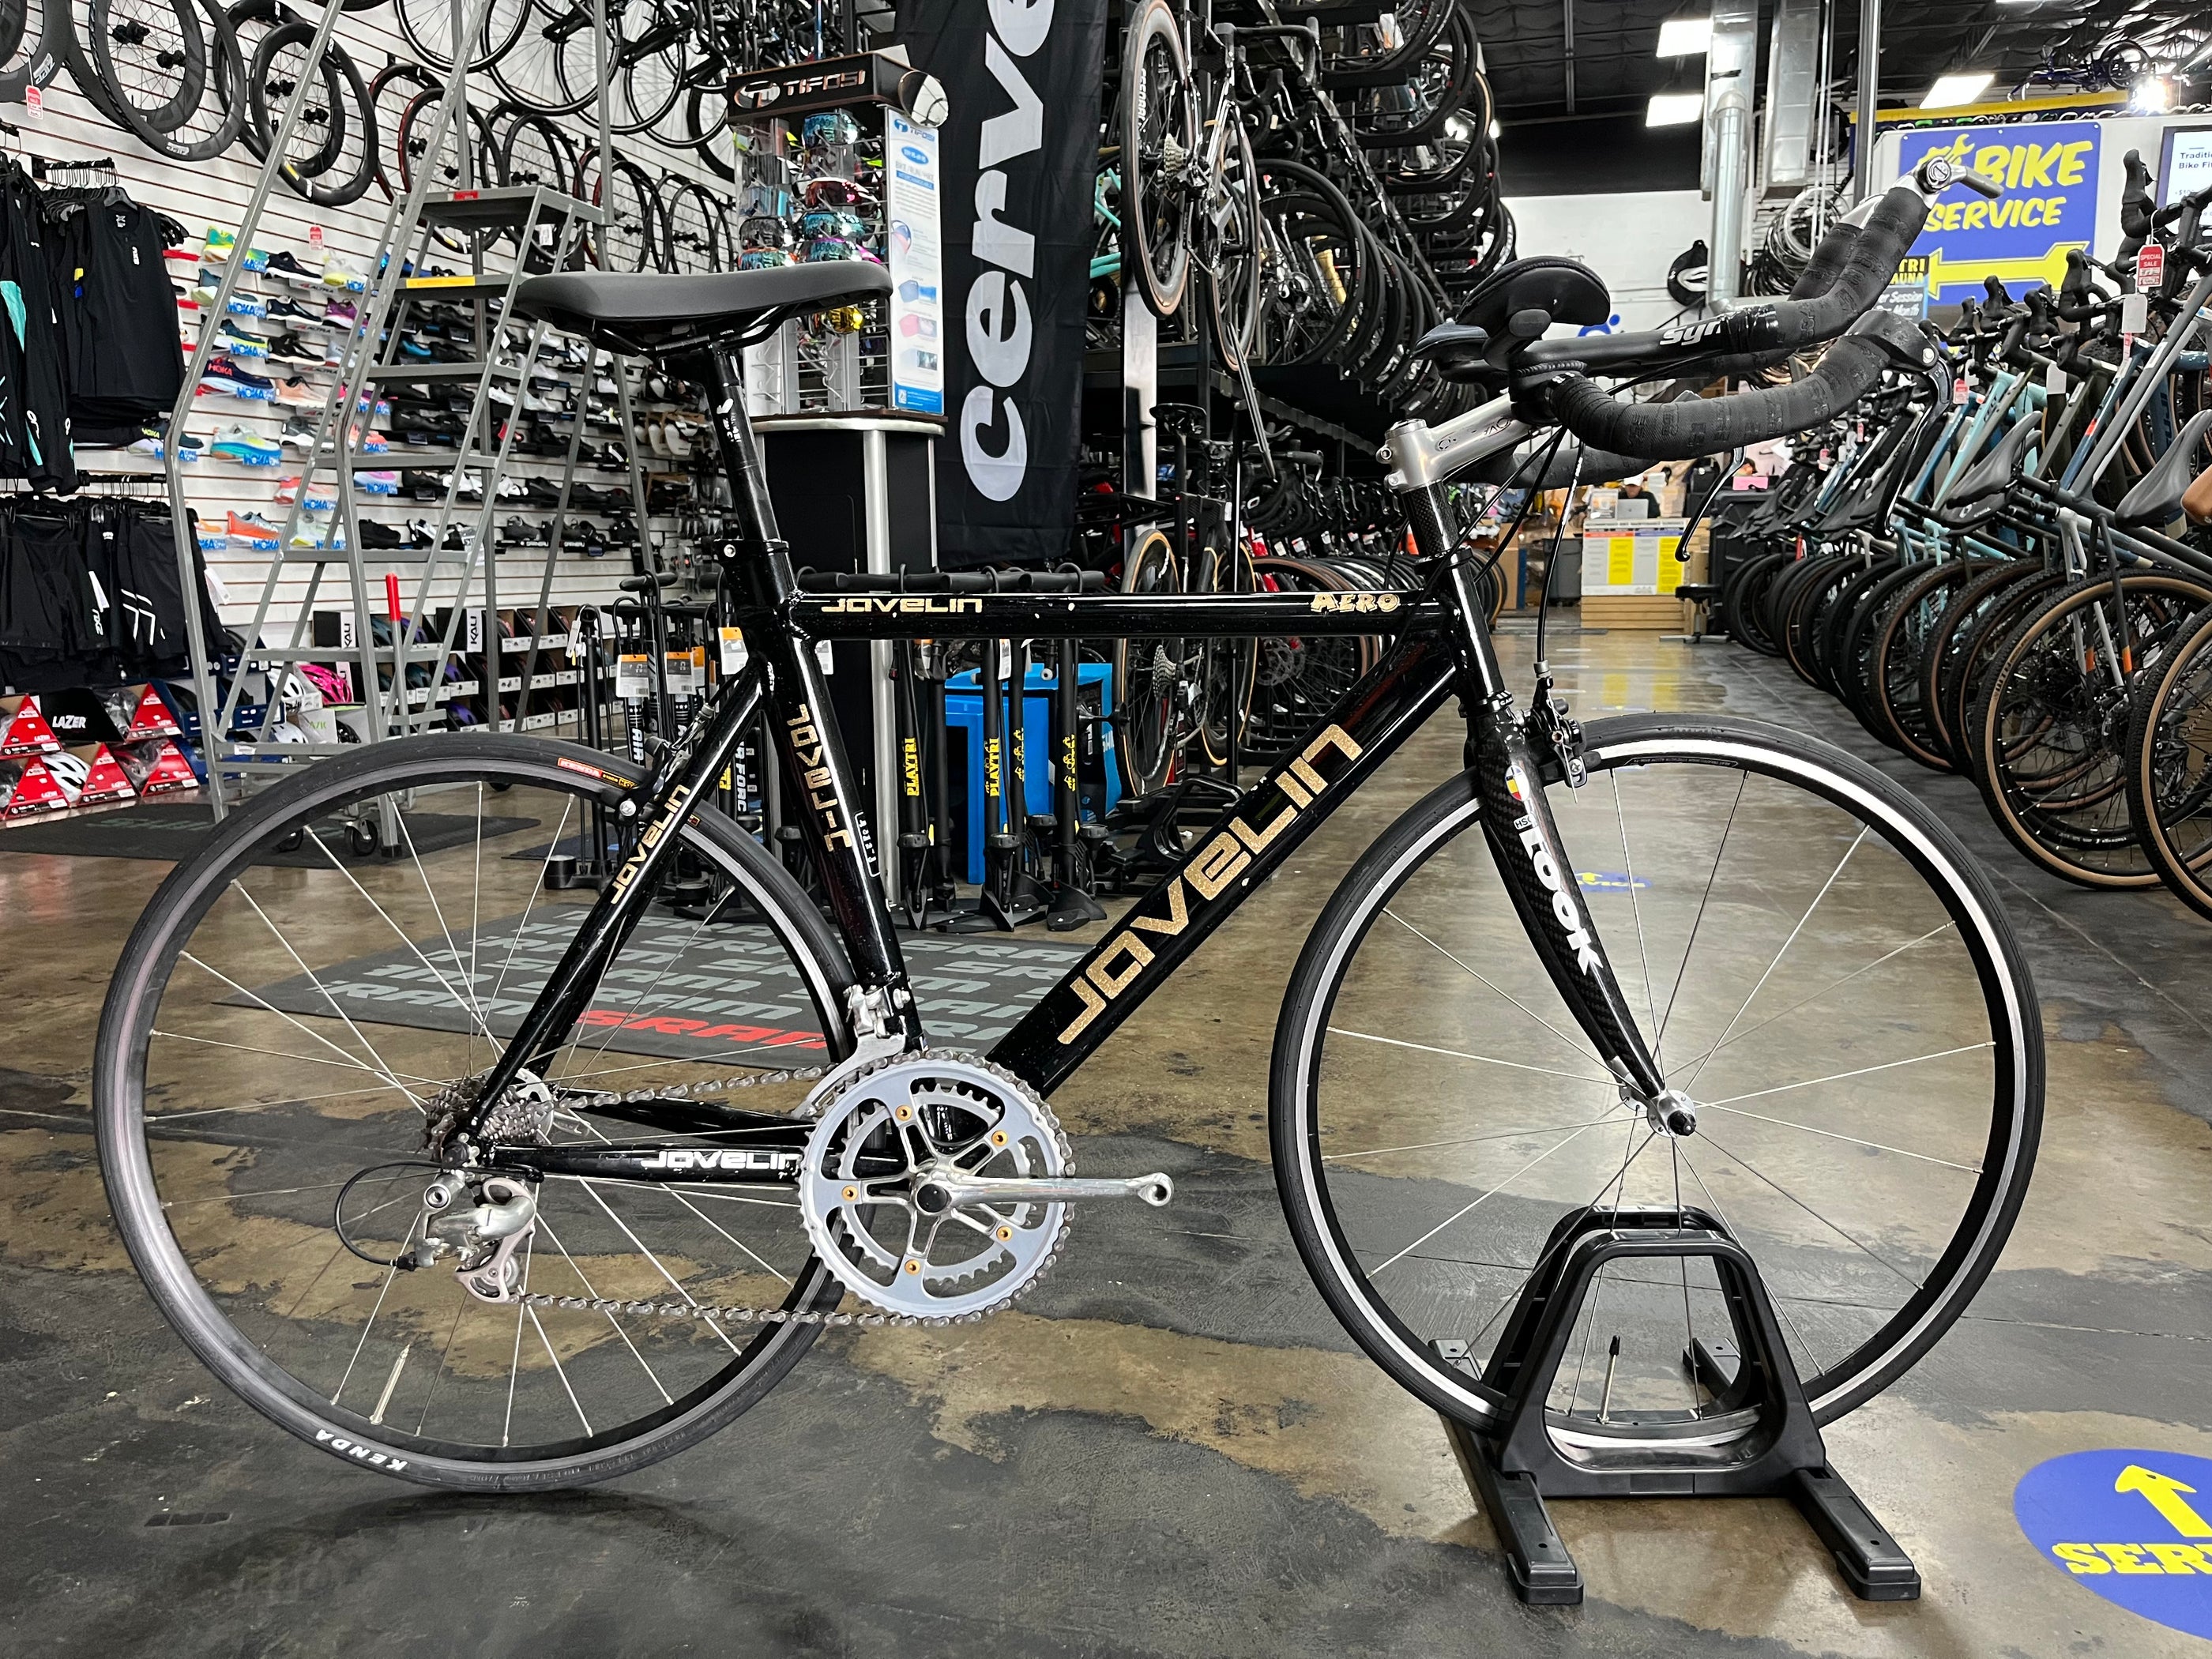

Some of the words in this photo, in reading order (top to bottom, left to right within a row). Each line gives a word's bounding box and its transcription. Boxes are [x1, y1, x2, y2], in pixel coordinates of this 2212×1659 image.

[784, 70, 866, 96] TIFOSI
[1974, 140, 2094, 190] BIKE
[1923, 197, 2067, 232] SERVICE
[1898, 258, 1925, 273] TRI
[208, 364, 233, 376] HOKA
[1311, 592, 1401, 613] AERO
[52, 715, 86, 729] LAZER
[905, 737, 920, 796] PLAYTRI
[990, 738, 1000, 796] PLAYTRI
[1519, 827, 1604, 976] LOOK
[316, 1429, 408, 1471] KENDA
